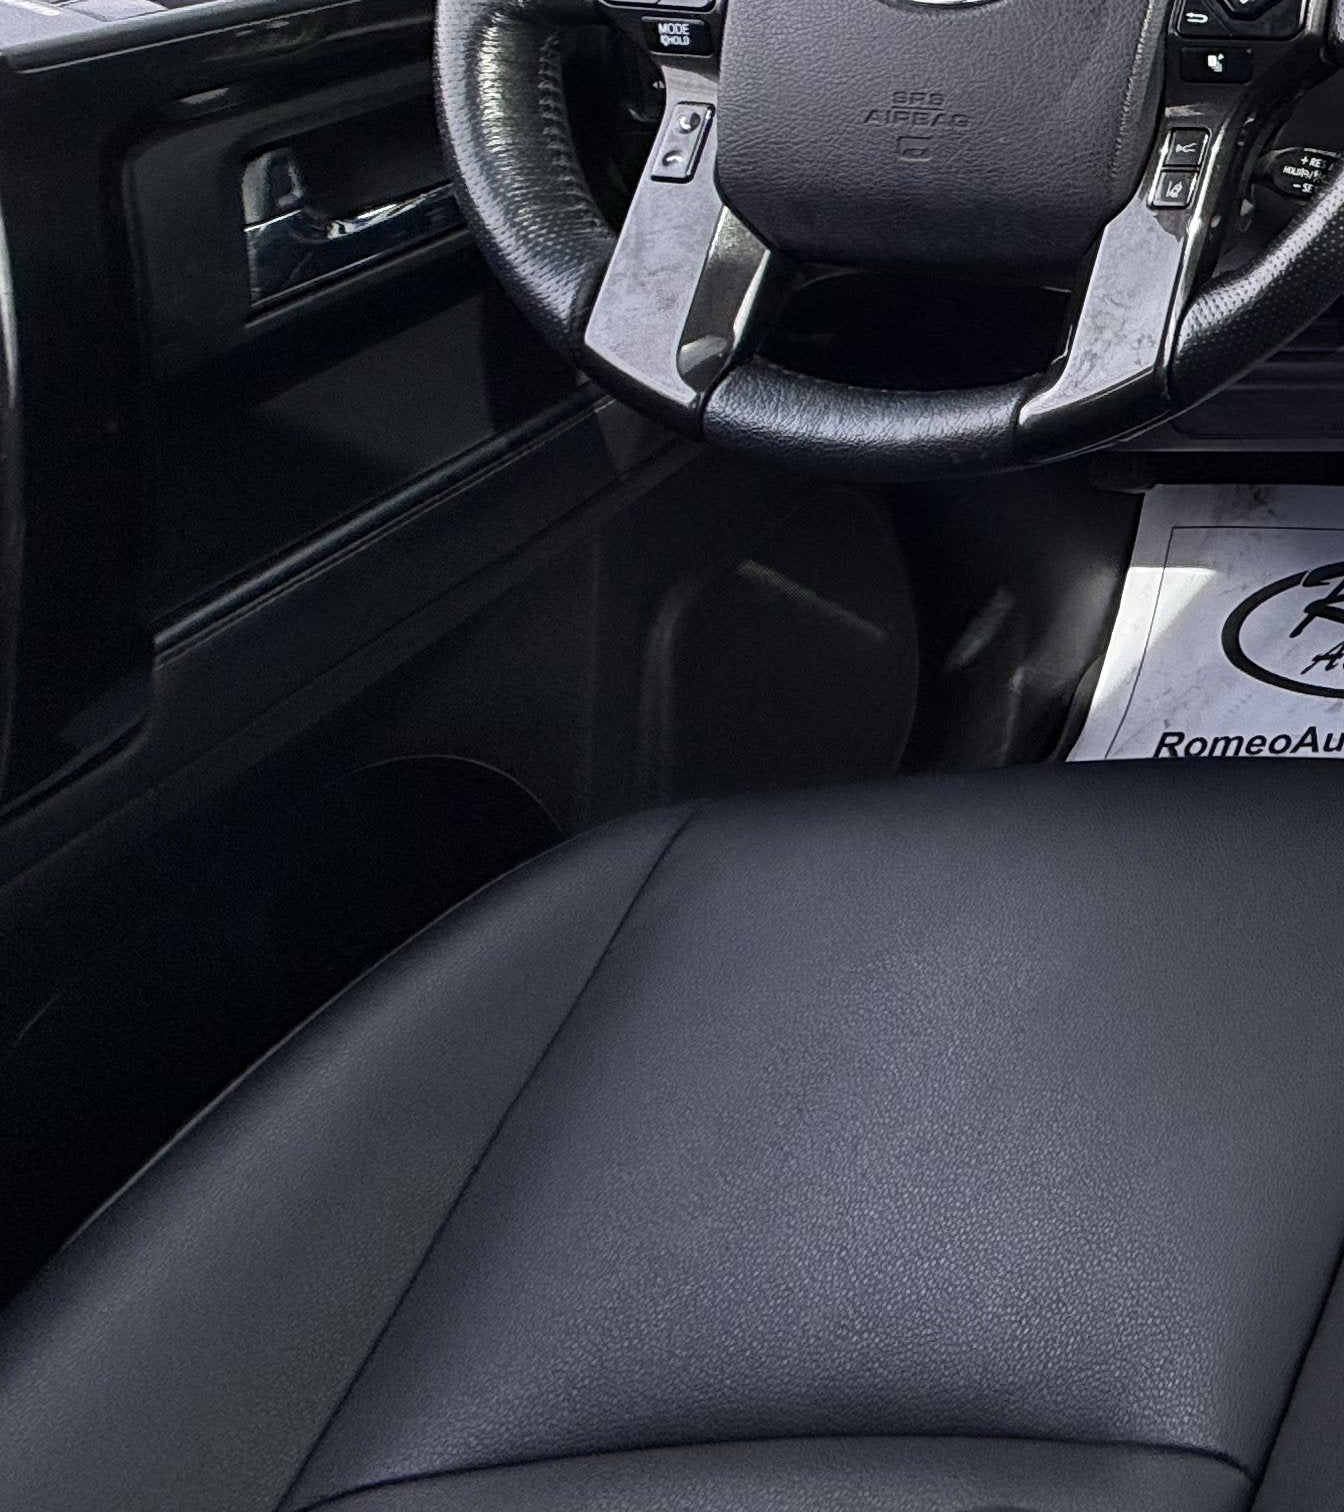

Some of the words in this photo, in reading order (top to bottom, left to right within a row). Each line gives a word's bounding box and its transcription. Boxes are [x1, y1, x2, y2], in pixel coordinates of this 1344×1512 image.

[658, 23, 690, 35] MODE
[891, 90, 945, 105] SRS
[863, 108, 973, 128] AIRBAG
